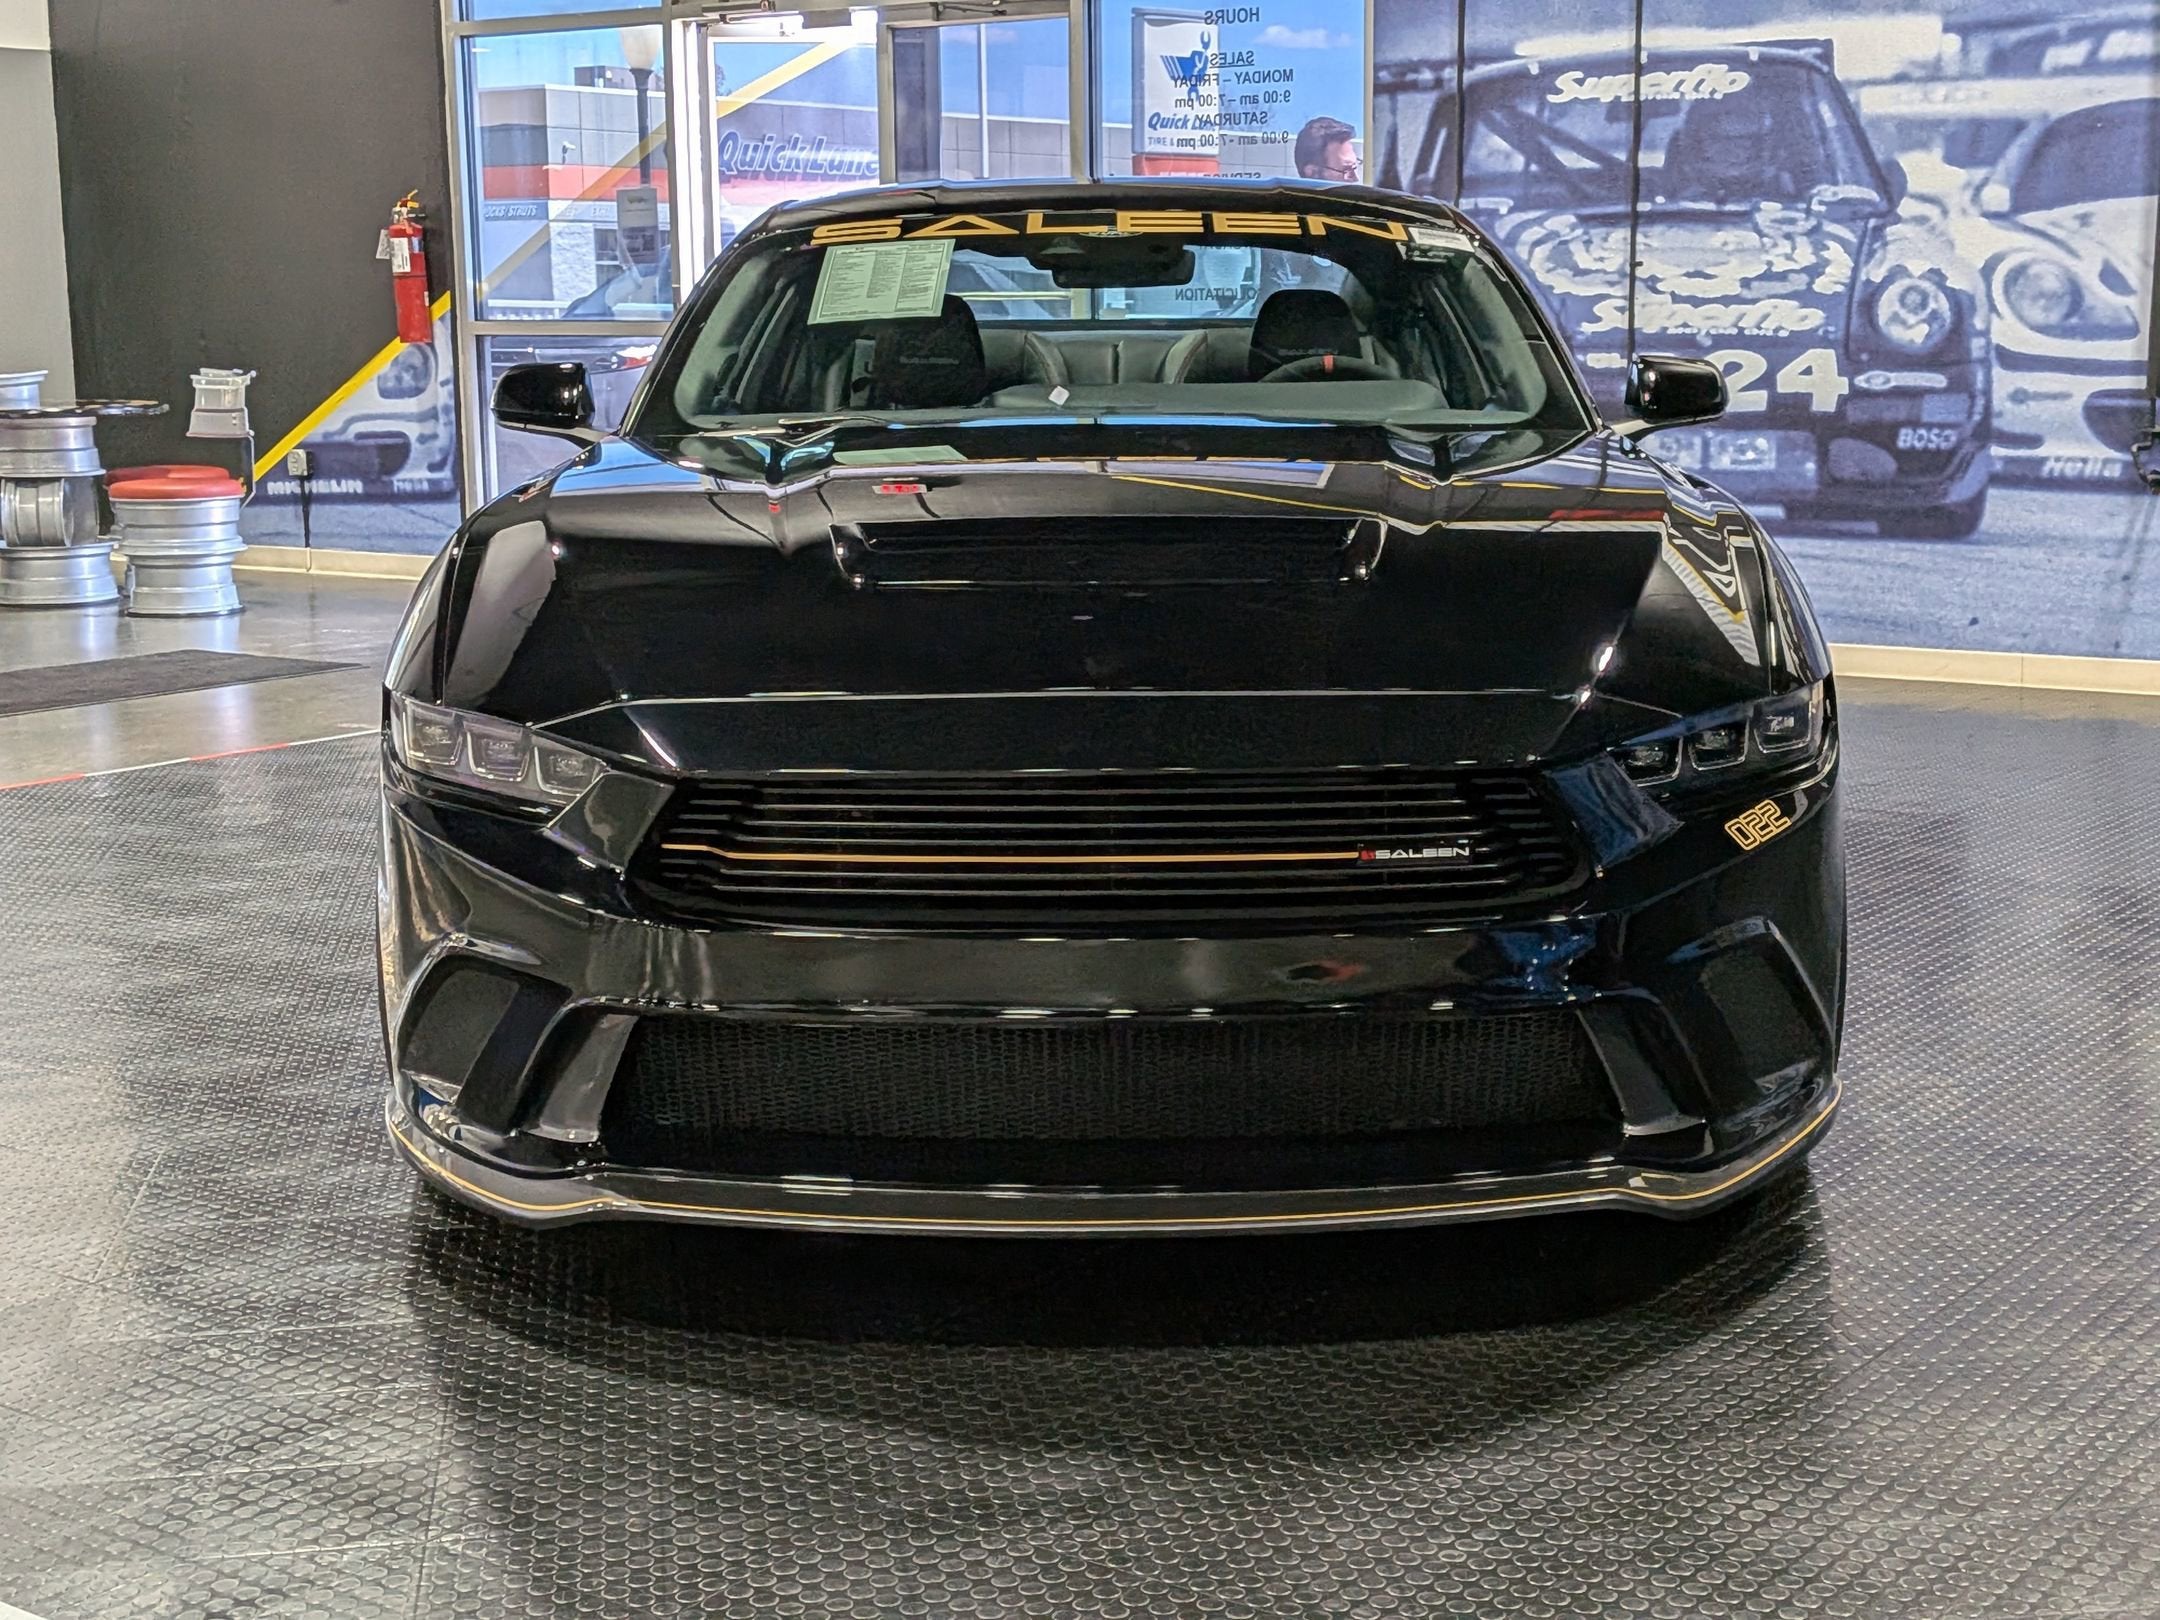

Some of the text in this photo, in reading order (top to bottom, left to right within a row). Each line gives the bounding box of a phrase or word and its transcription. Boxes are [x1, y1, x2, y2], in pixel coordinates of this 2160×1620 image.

[1148, 111, 1190, 131] Quick
[1147, 137, 1168, 147] TIRE
[810, 211, 1409, 246] SALEEN
[267, 479, 364, 495] MICHELIN
[1724, 799, 1792, 850] 022
[1375, 847, 1470, 860] SALEEN
